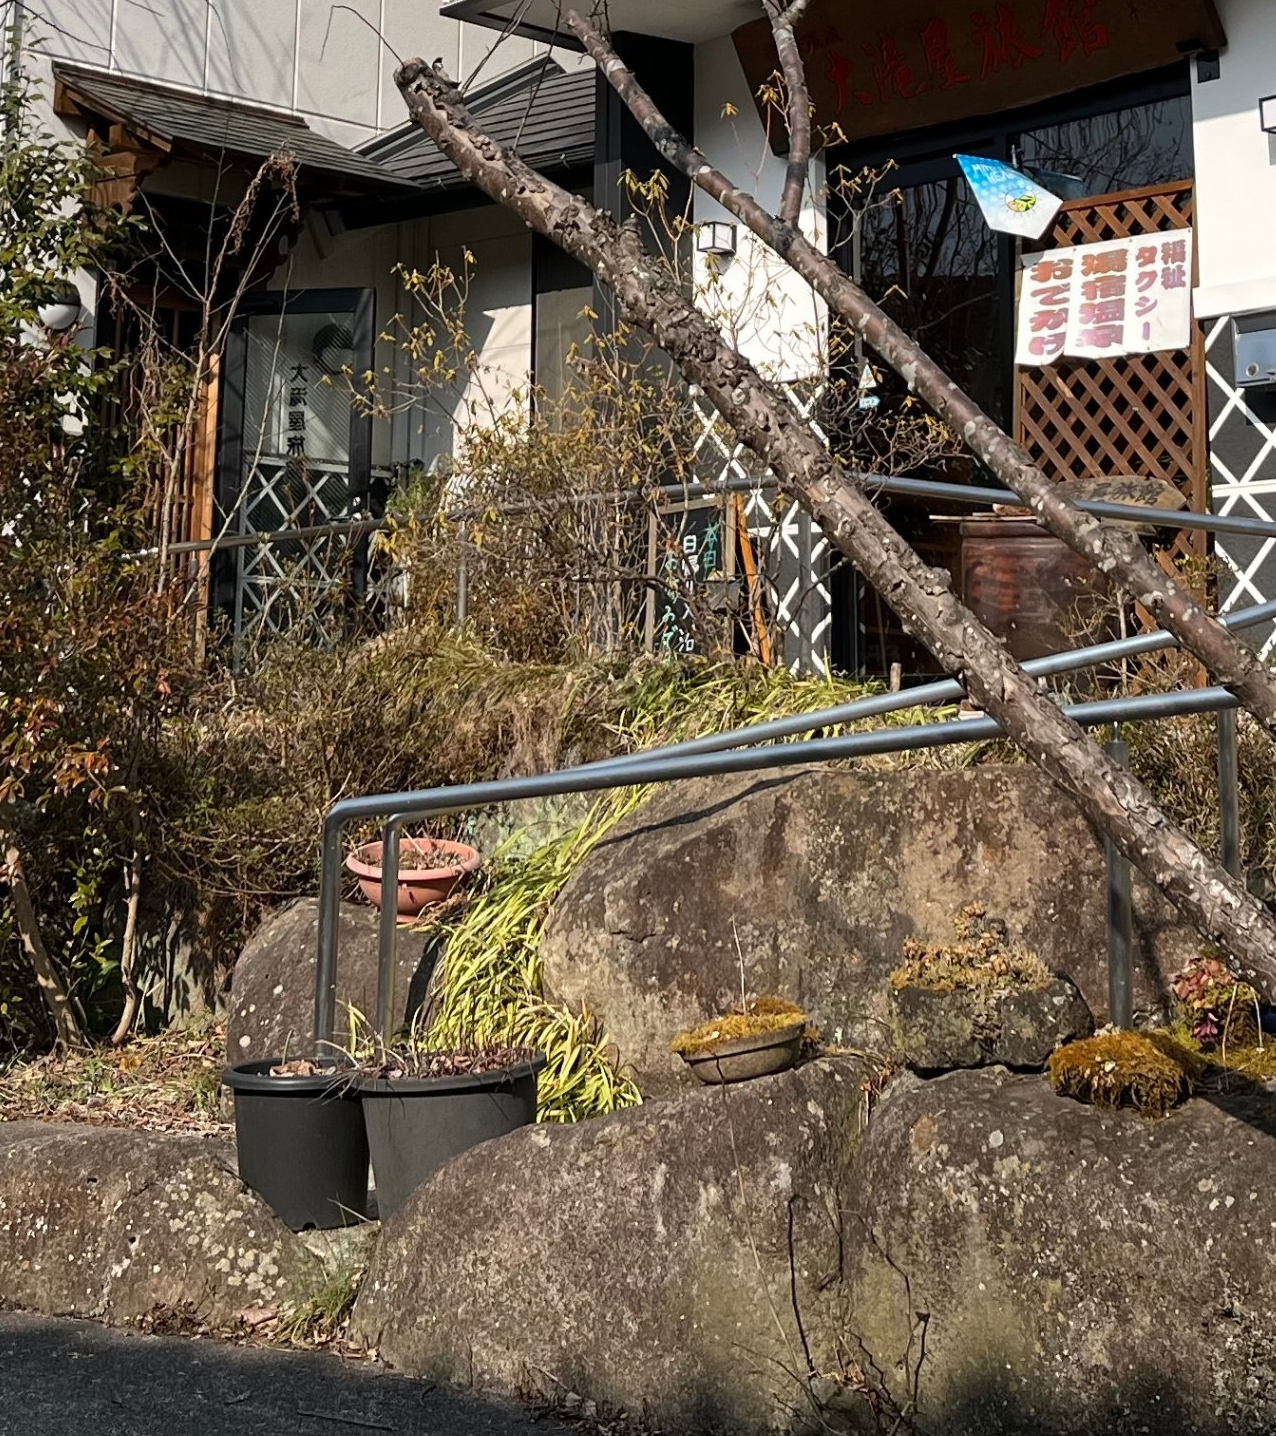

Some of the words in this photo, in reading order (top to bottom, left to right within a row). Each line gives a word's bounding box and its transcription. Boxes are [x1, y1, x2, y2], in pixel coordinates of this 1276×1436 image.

[1028, 258, 1073, 356] おでかけ
[1075, 248, 1129, 348] 湯宿温泉
[1134, 246, 1158, 341] タクシー
[1161, 239, 1186, 290] 福祉
